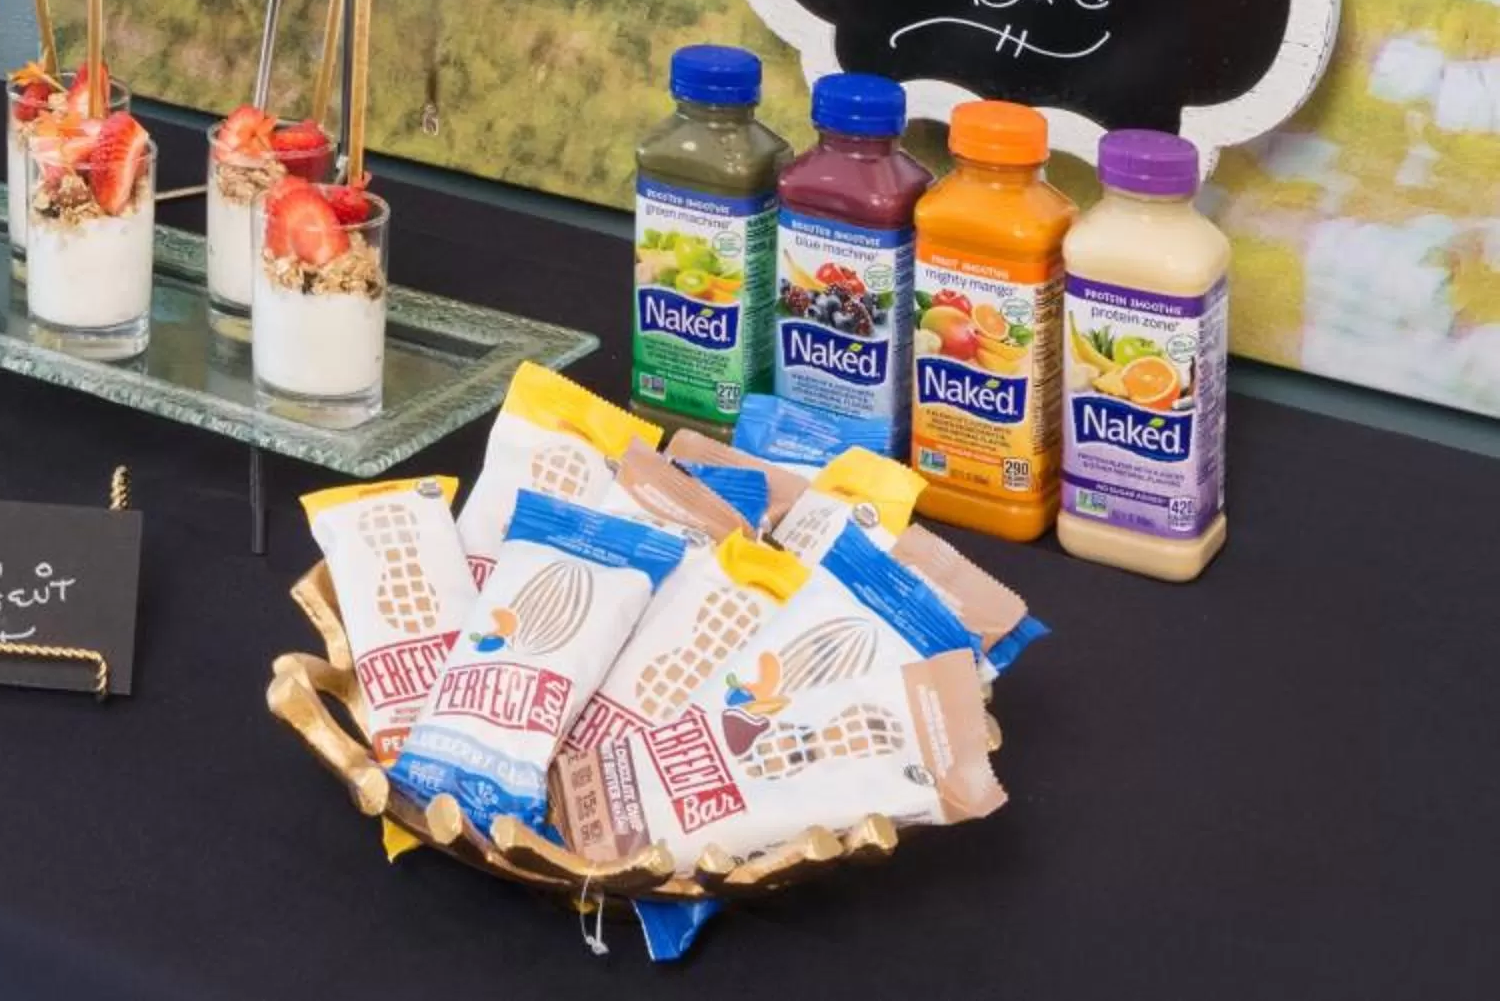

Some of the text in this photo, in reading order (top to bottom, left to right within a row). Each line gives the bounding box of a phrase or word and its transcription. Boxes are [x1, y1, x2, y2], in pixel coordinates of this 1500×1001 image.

[644, 203, 677, 219] green
[794, 235, 821, 249] blue
[924, 267, 967, 288] mighty
[644, 295, 731, 343] Naked
[1084, 288, 1183, 316] PROTEIN SMOOTHIE
[1090, 306, 1140, 324] protein
[790, 329, 881, 378] Naked
[924, 365, 1018, 416] Naked
[1083, 404, 1185, 455] Naked
[1004, 459, 1029, 476] 290
[435, 666, 569, 732] PERFECT Bar
[650, 709, 743, 831] ERFECT Bar
